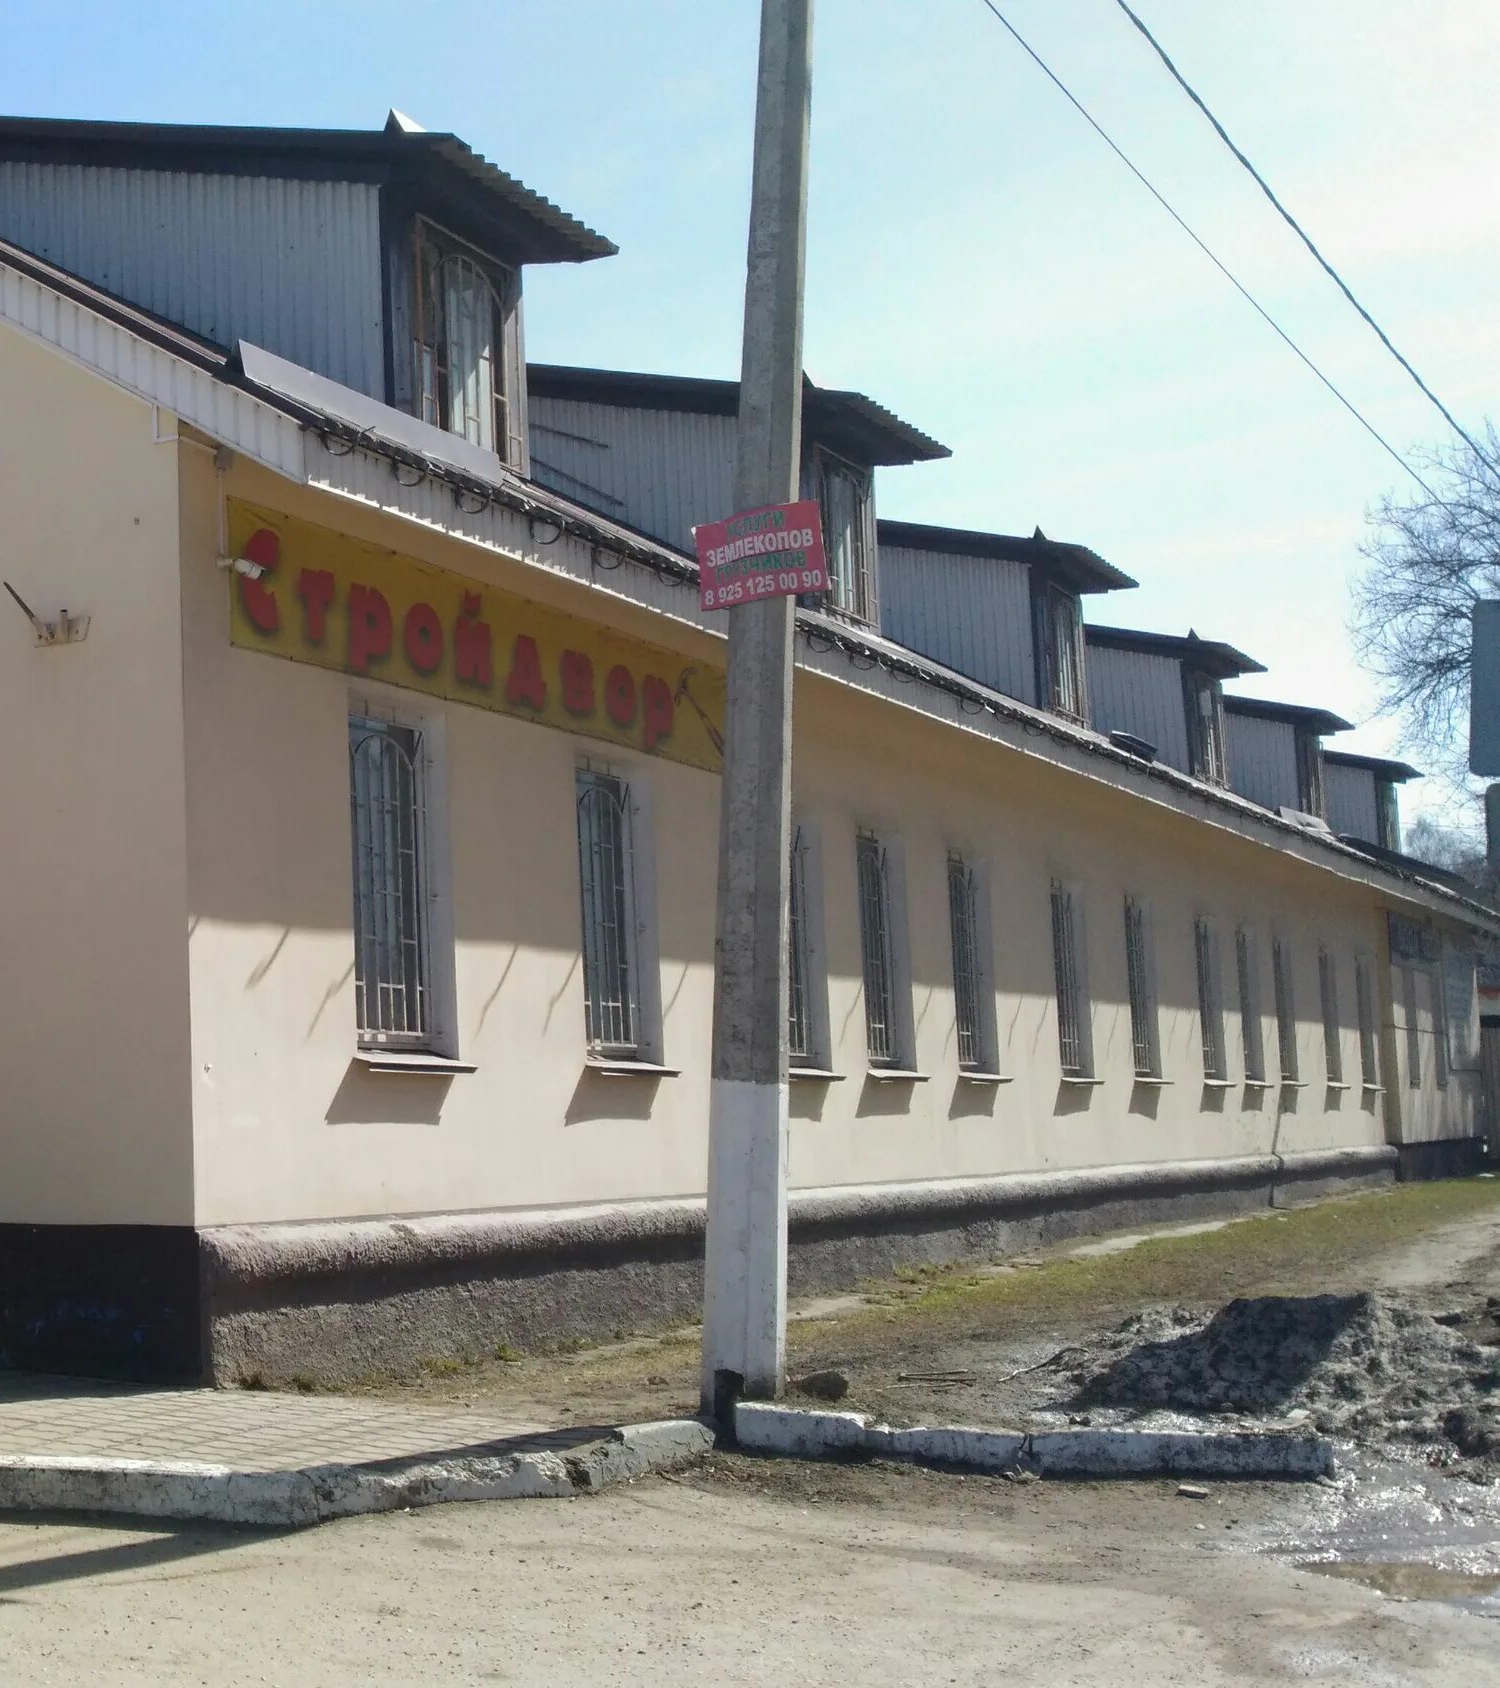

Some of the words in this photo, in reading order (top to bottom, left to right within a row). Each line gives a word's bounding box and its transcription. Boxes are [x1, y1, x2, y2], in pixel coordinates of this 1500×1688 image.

[706, 528, 814, 568] ЗЕМЛЕКОПОВ
[704, 590, 714, 606] 8
[718, 581, 743, 604] 925
[746, 574, 775, 595] 125
[778, 572, 798, 590] 00
[802, 569, 822, 588] 90
